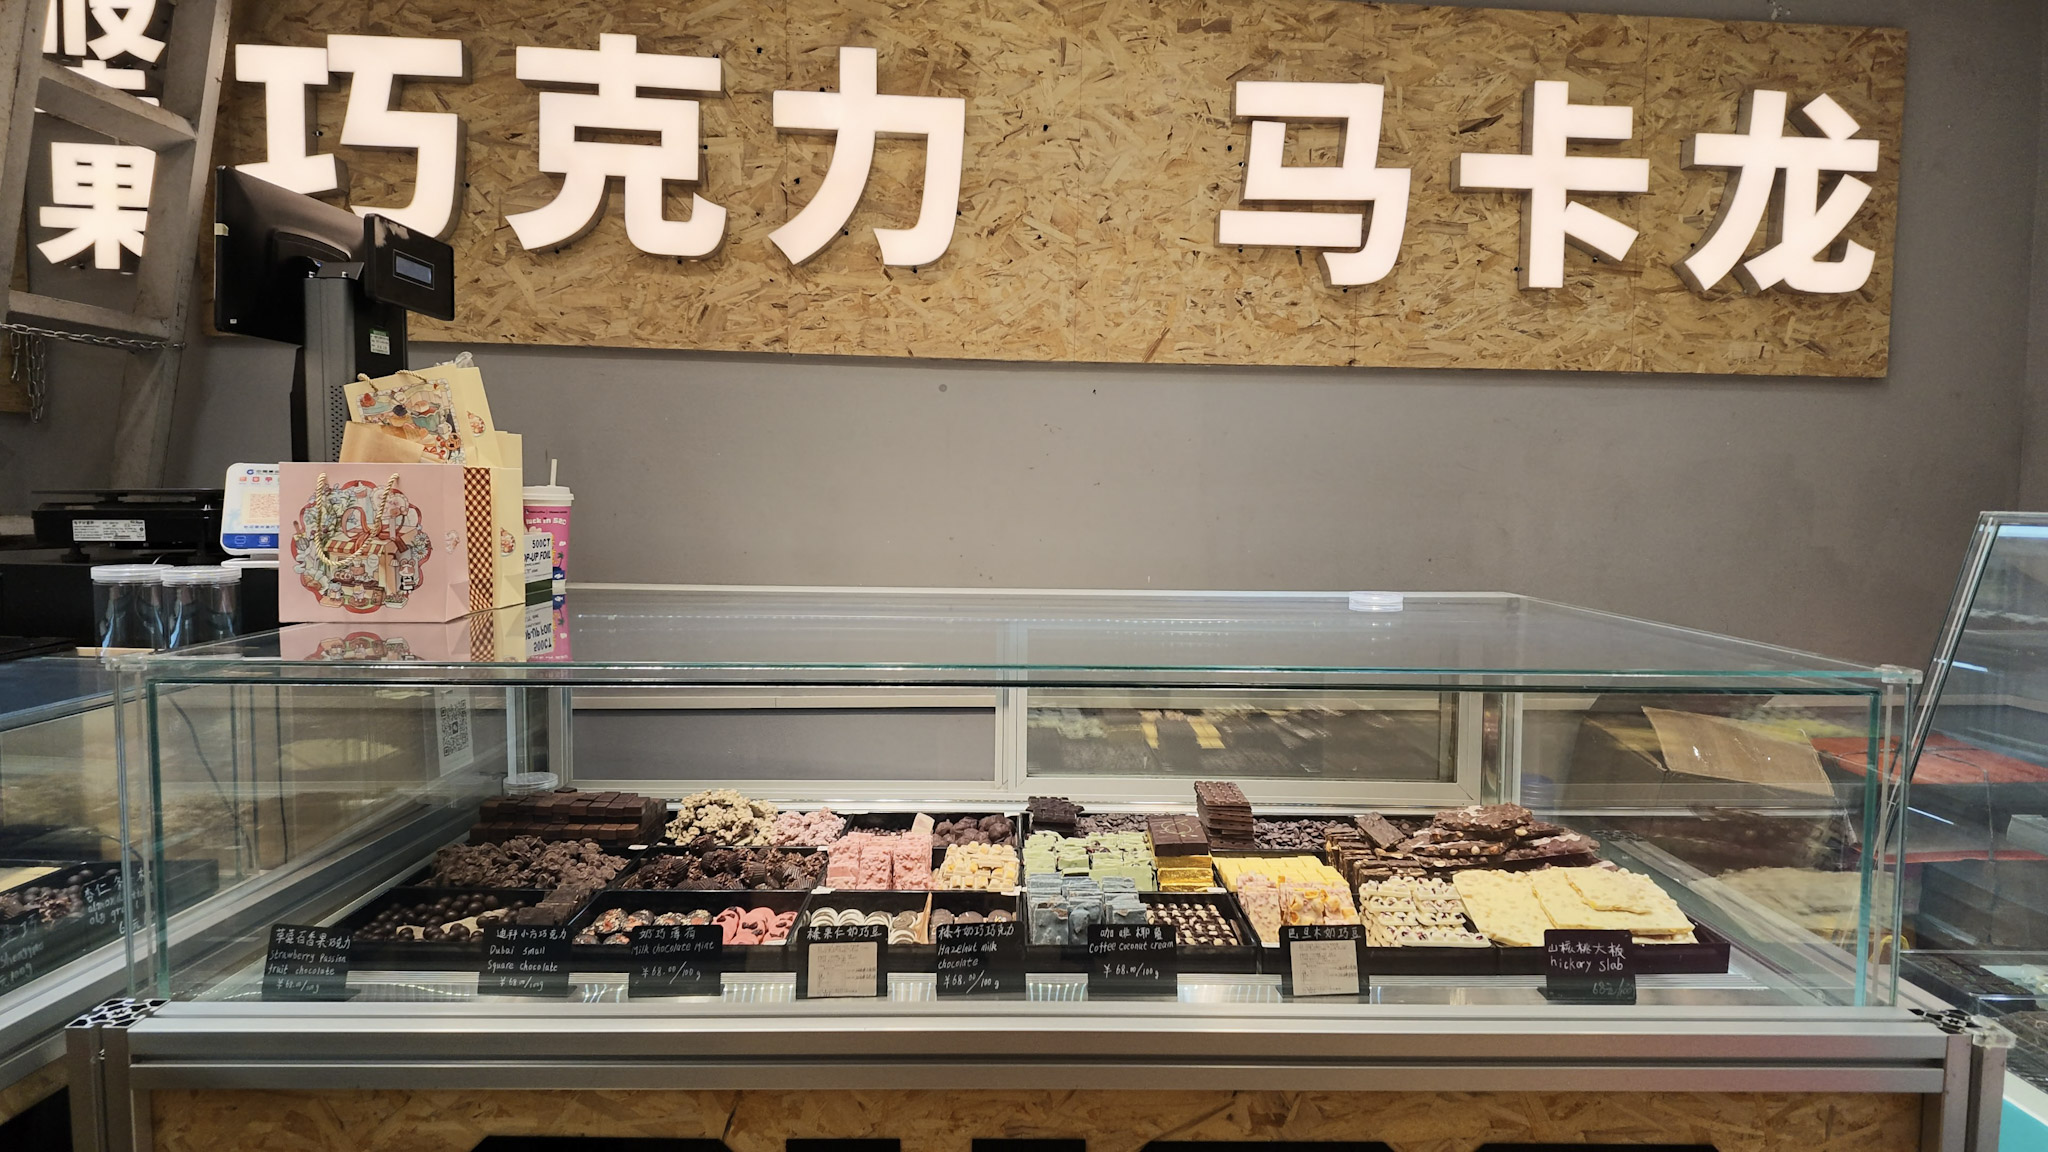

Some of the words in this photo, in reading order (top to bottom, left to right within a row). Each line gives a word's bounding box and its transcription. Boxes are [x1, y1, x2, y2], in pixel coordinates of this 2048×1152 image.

[234, 33, 966, 267] 巧克力
[1218, 80, 1880, 293] 马卡龙
[276, 928, 351, 949] 草莓百香果巧克力
[638, 926, 697, 940] 奶巧薄荷
[1288, 926, 1361, 940] 巴旦木奶巧豆
[489, 944, 515, 955] Dubai
[937, 941, 978, 956] Hazelnut
[1150, 941, 1174, 950] cream
[1547, 940, 1626, 960] 山核桃大板
[295, 965, 335, 976] chocolate
[519, 960, 559, 972] chocolate
[937, 958, 979, 970] chocolate
